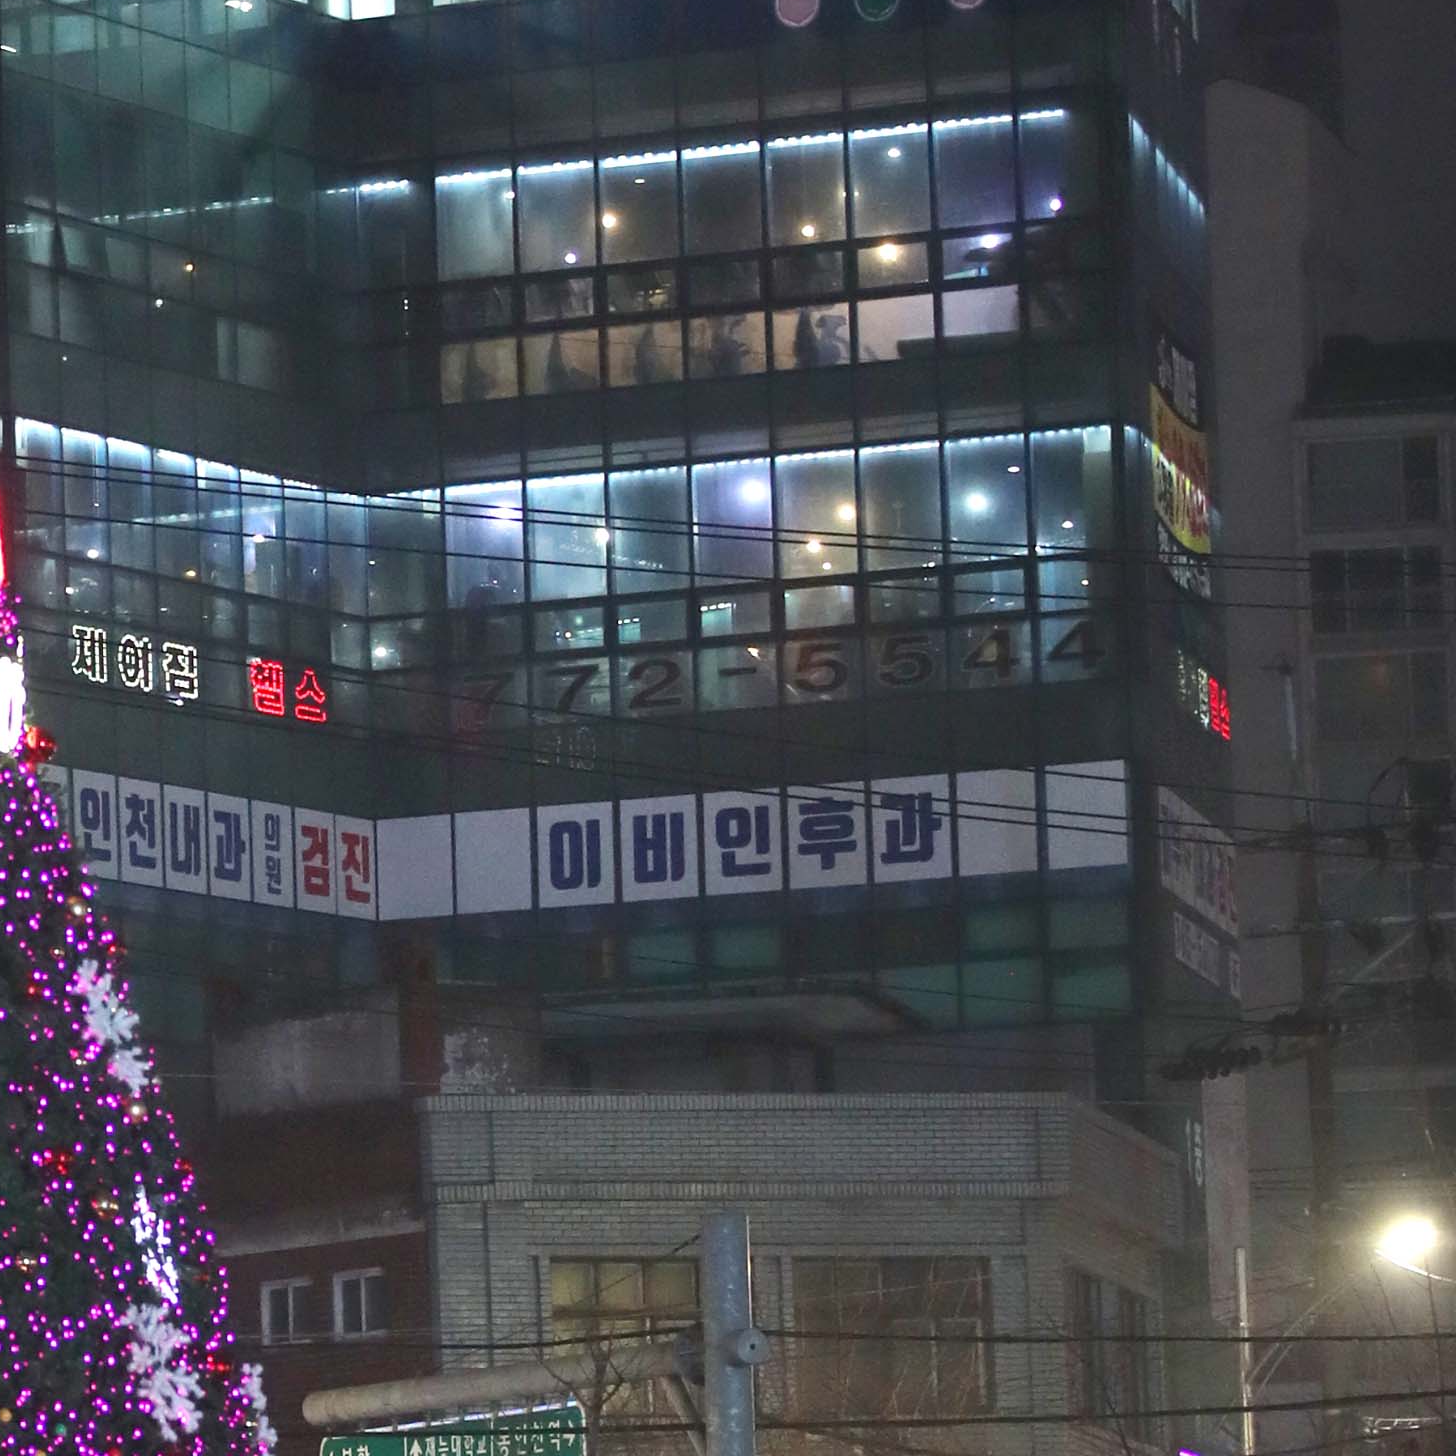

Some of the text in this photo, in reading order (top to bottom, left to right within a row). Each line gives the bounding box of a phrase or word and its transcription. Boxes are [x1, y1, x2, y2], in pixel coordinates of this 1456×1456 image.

[248, 657, 327, 723] 헬스
[300, 825, 371, 904] 검진
[549, 792, 943, 893] 이비인후과
